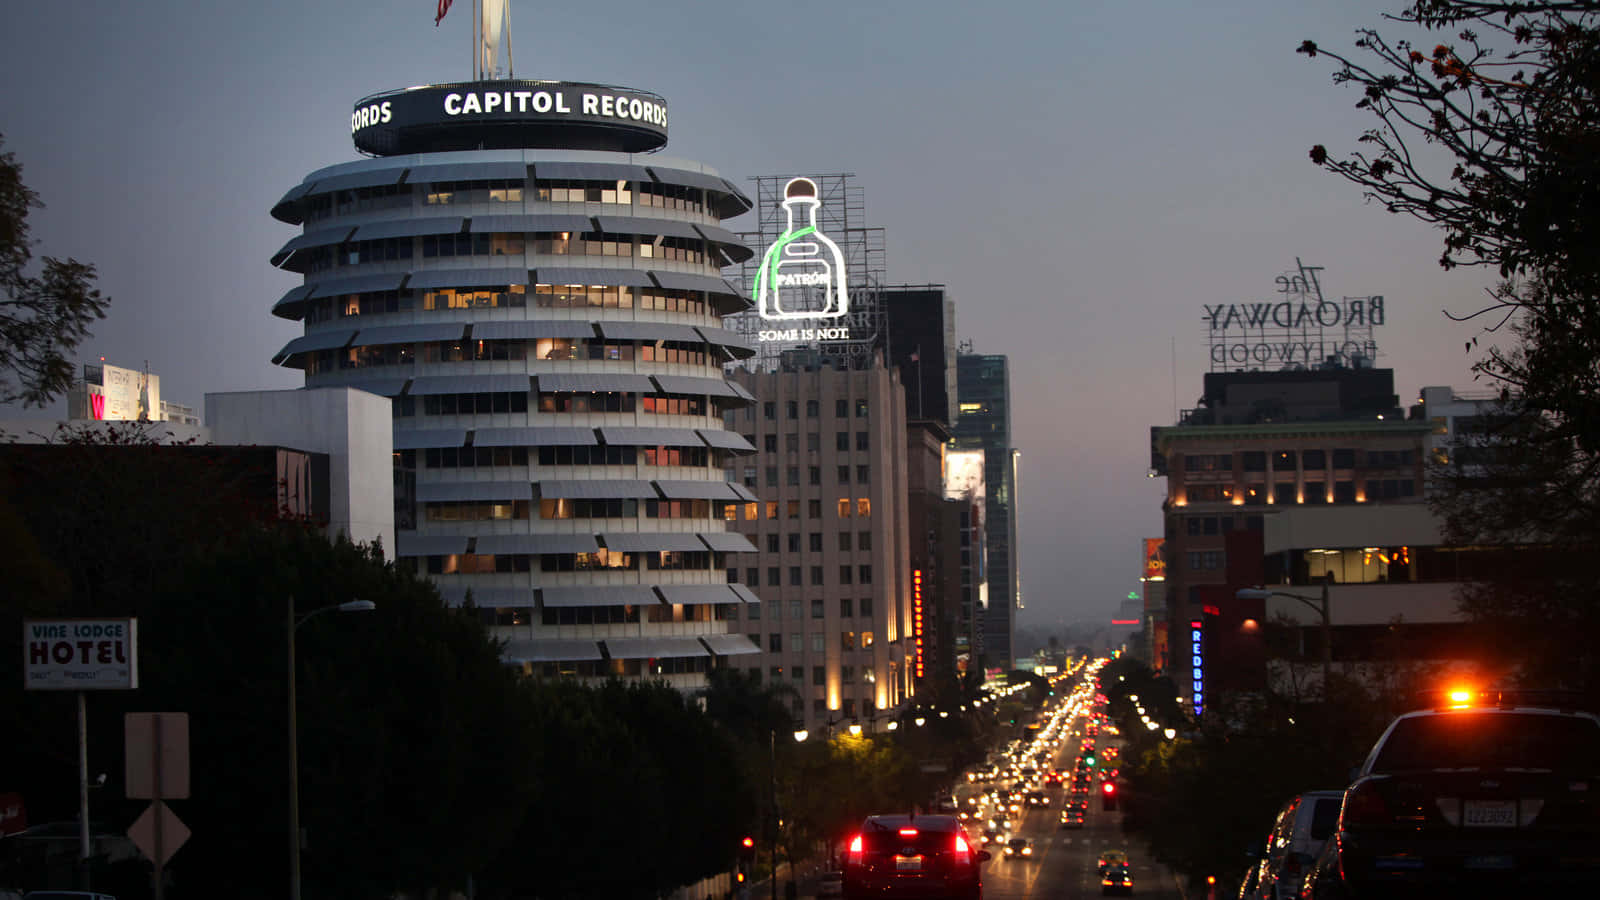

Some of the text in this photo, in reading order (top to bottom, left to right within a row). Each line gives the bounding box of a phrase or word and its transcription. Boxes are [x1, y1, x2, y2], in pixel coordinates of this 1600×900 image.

[444, 91, 667, 128] CAPITOL RECORDS
[759, 327, 849, 342] SOME IS NOT.
[90, 392, 105, 420] W
[32, 624, 123, 638] VINE LODGE
[30, 641, 126, 664] HOTEL
[1192, 630, 1203, 715] REDBURY
